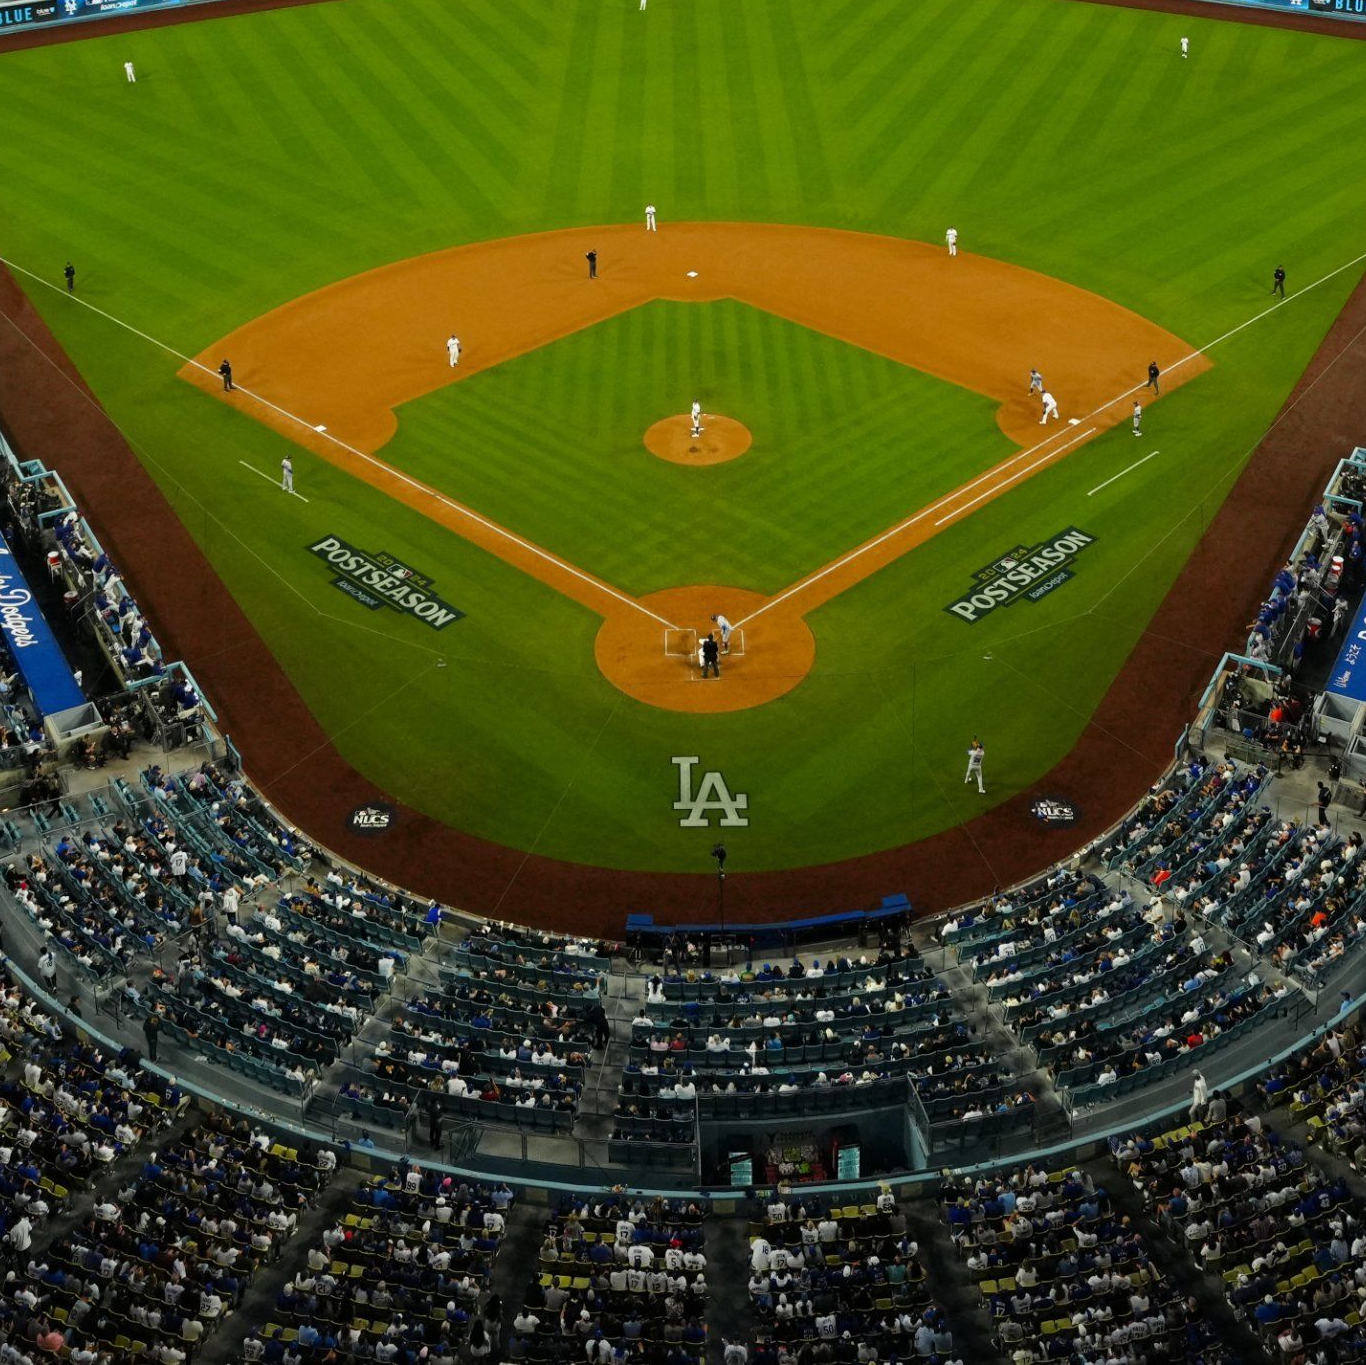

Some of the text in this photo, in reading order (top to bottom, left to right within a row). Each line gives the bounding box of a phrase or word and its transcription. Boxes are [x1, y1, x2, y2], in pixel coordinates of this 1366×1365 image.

[1011, 548, 1028, 560] 24
[950, 530, 1093, 622] POSTSEASON
[311, 537, 457, 627] POSTSEASON
[1028, 572, 1069, 600] loanDepot
[671, 756, 749, 827] LA
[1037, 807, 1074, 816] NLCS
[353, 814, 390, 824] NLCS
[175, 858, 183, 867] 17
[406, 1181, 417, 1191] 99
[772, 1213, 783, 1221] 50
[671, 1257, 677, 1267] 5
[200, 1302, 211, 1312] 27
[823, 1324, 834, 1334] 50
